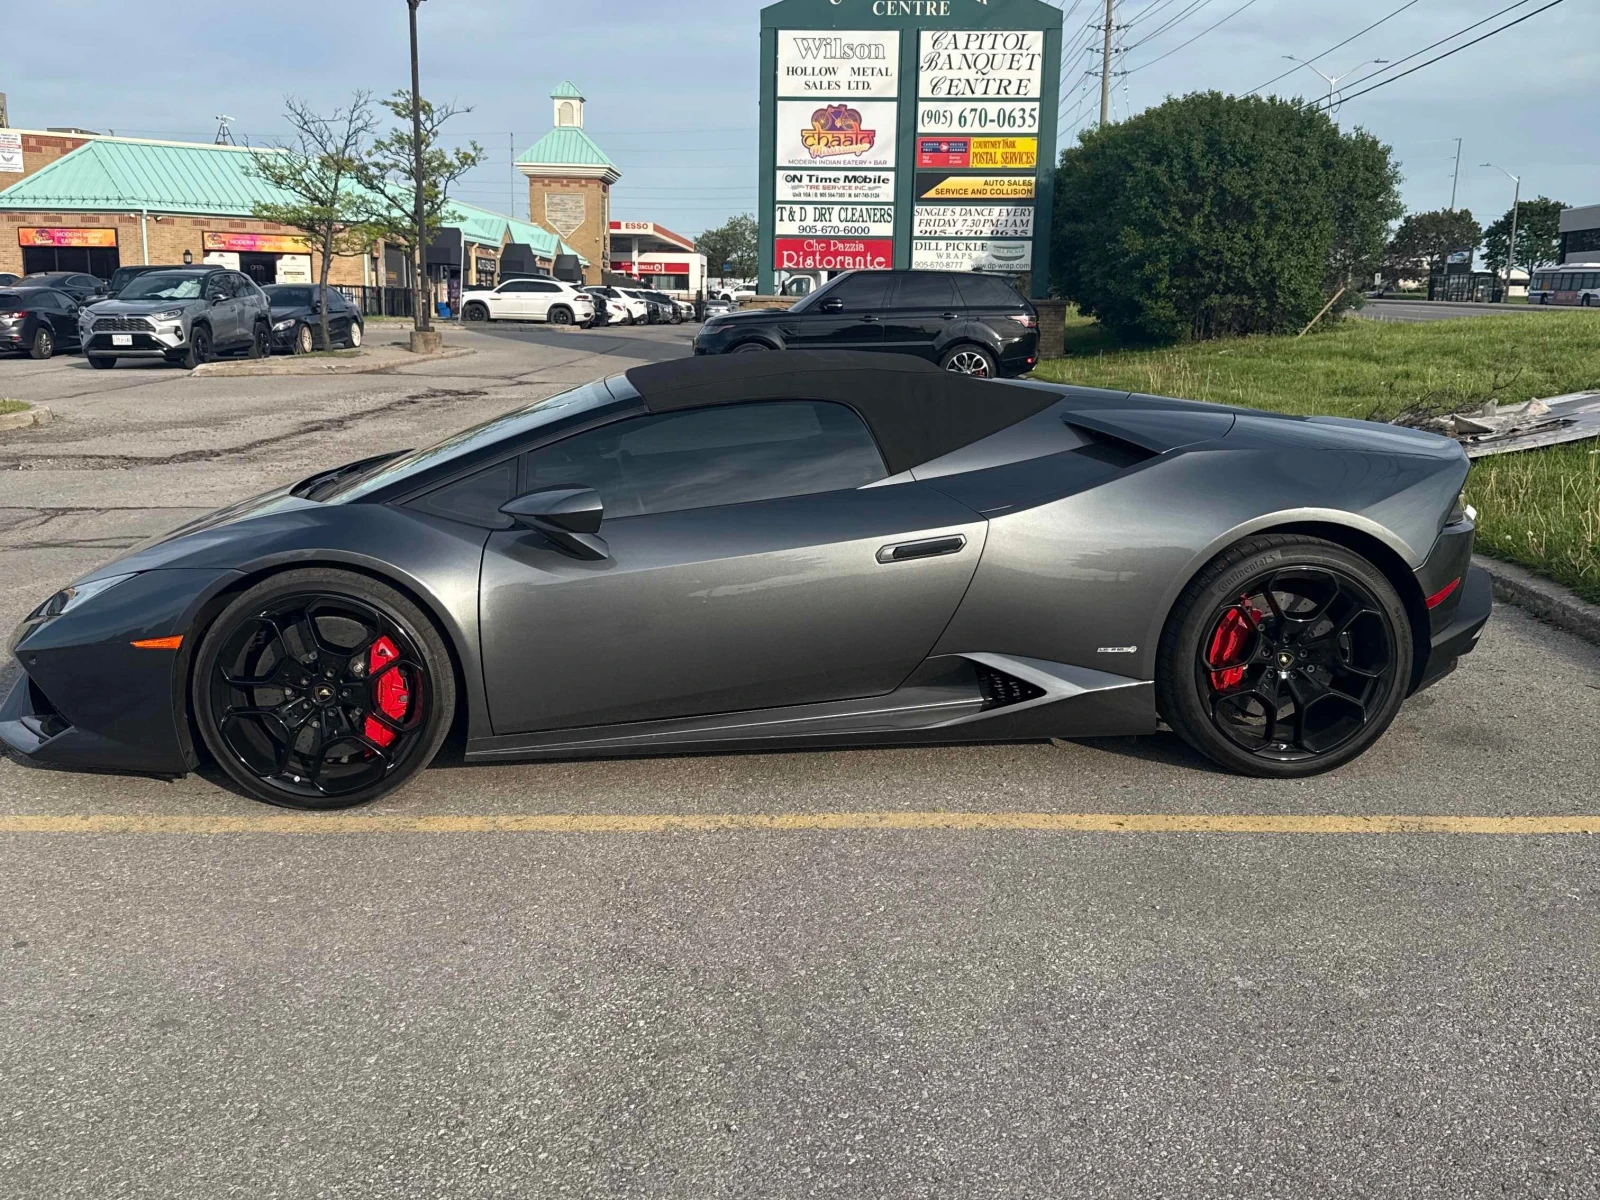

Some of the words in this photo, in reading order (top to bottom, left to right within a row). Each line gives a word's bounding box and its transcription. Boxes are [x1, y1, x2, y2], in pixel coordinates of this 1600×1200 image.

[872, 0, 951, 16] CENTRE
[931, 31, 1033, 51] CAPITOL
[793, 37, 886, 60] Wilson
[920, 51, 1042, 76] BANQUET
[786, 66, 839, 77] HOLLOW
[850, 66, 893, 77] METAL
[804, 80, 841, 91] SALES
[847, 80, 872, 91] LTD.
[930, 76, 1031, 97] CENTRE
[921, 109, 953, 128] (905)
[958, 107, 1037, 128] 670-0635
[973, 140, 1001, 150] COURTNEY
[971, 152, 998, 165] POSTAL
[1001, 152, 1036, 165] SERVICES
[785, 174, 803, 183] ON
[806, 175, 841, 184] Time
[935, 188, 969, 196] SERVICE
[970, 188, 988, 196] AND
[989, 188, 1033, 196] COLLISION
[777, 206, 787, 222] T
[788, 206, 796, 222] &
[799, 206, 807, 222] D
[813, 207, 834, 222] DRY
[838, 207, 893, 223] CLEANERS
[914, 208, 956, 217] SINGLE'S
[959, 208, 995, 217] DANCE
[998, 208, 1034, 217] EVERY
[625, 222, 649, 230] ESSO
[918, 219, 958, 228] FRIDAY
[798, 225, 871, 235] 905-670-6000
[804, 240, 827, 251] Che
[830, 240, 865, 252] Pazzia
[915, 242, 942, 251] DILL
[945, 242, 989, 252] PICKLE
[782, 250, 886, 269] Ristorante
[914, 261, 963, 269] 905-670-8777
[1218, 554, 1270, 594] Continental
